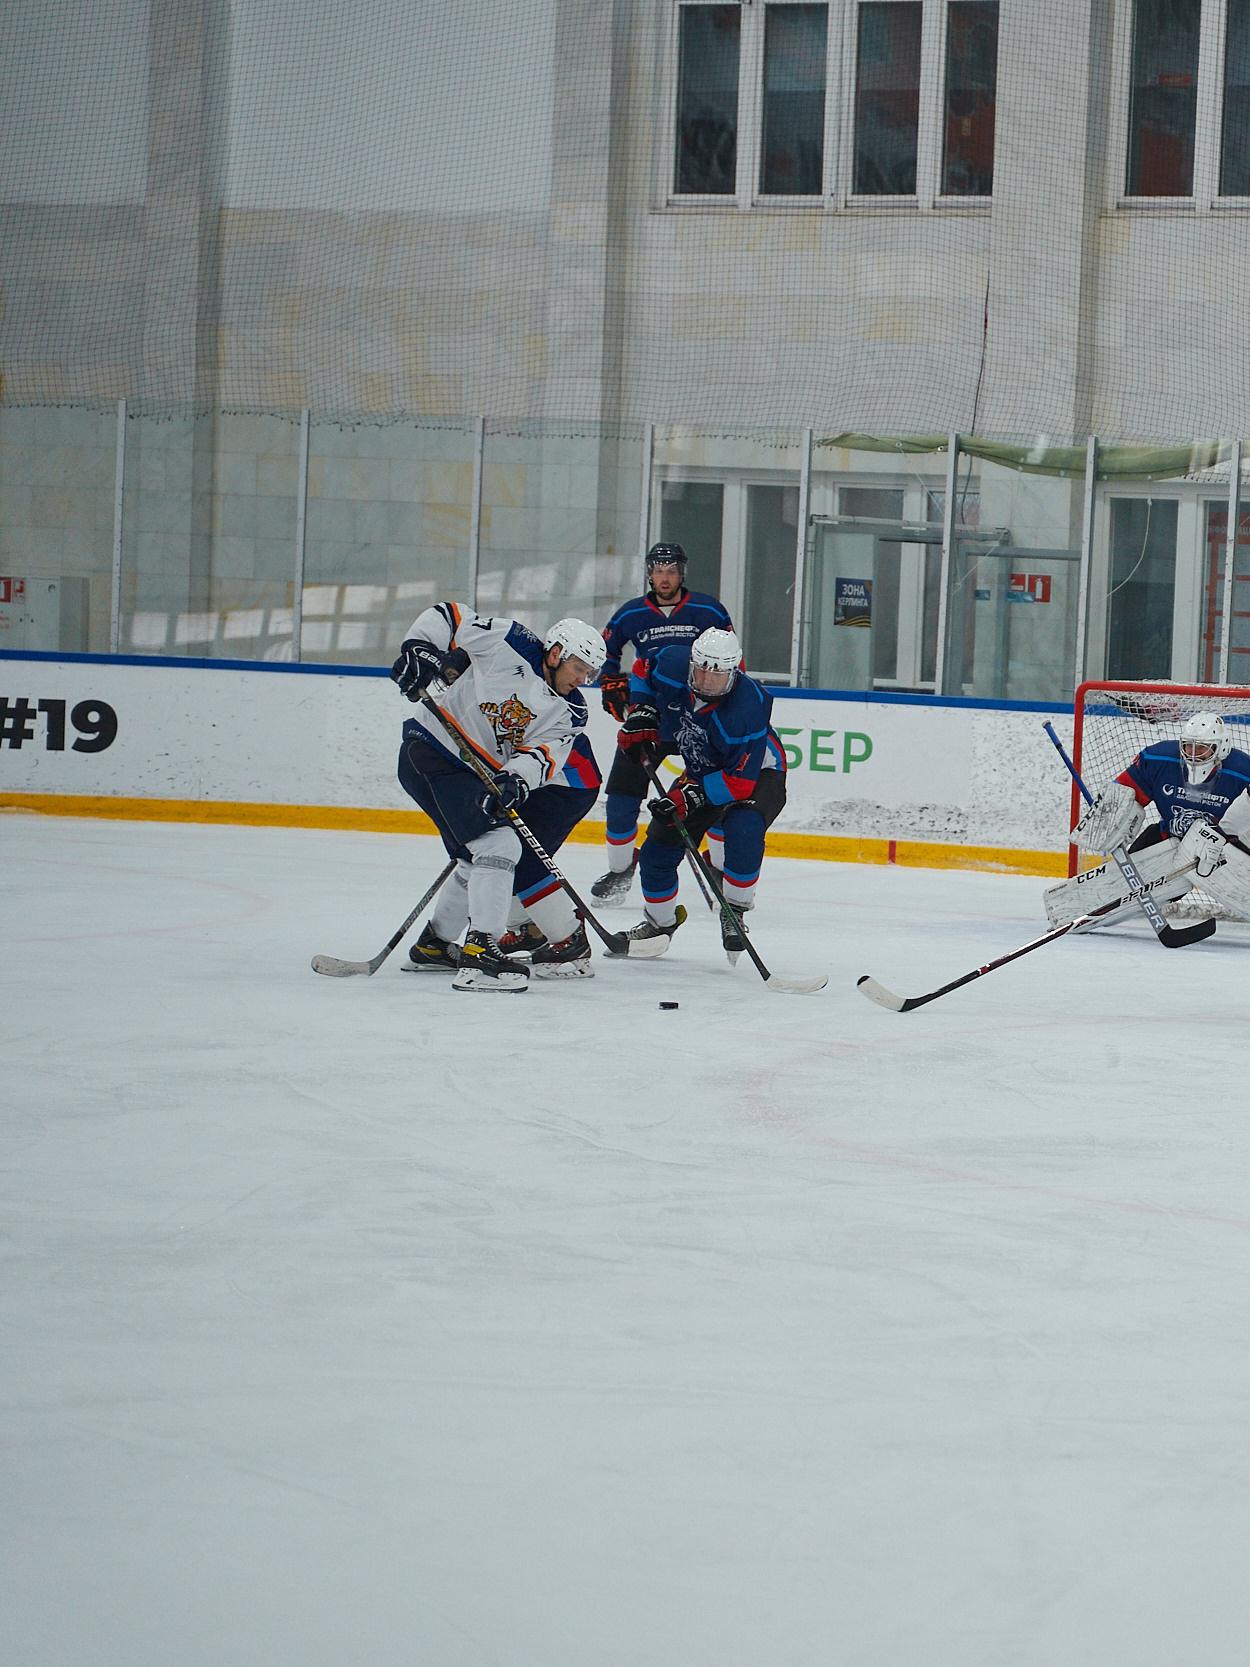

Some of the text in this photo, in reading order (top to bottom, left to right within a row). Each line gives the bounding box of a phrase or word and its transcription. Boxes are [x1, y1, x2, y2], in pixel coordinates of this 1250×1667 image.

[842, 583, 865, 596] ЗОНА
[0, 697, 118, 753] #19
[774, 727, 873, 774] БЕР
[1077, 865, 1107, 884] CCM
